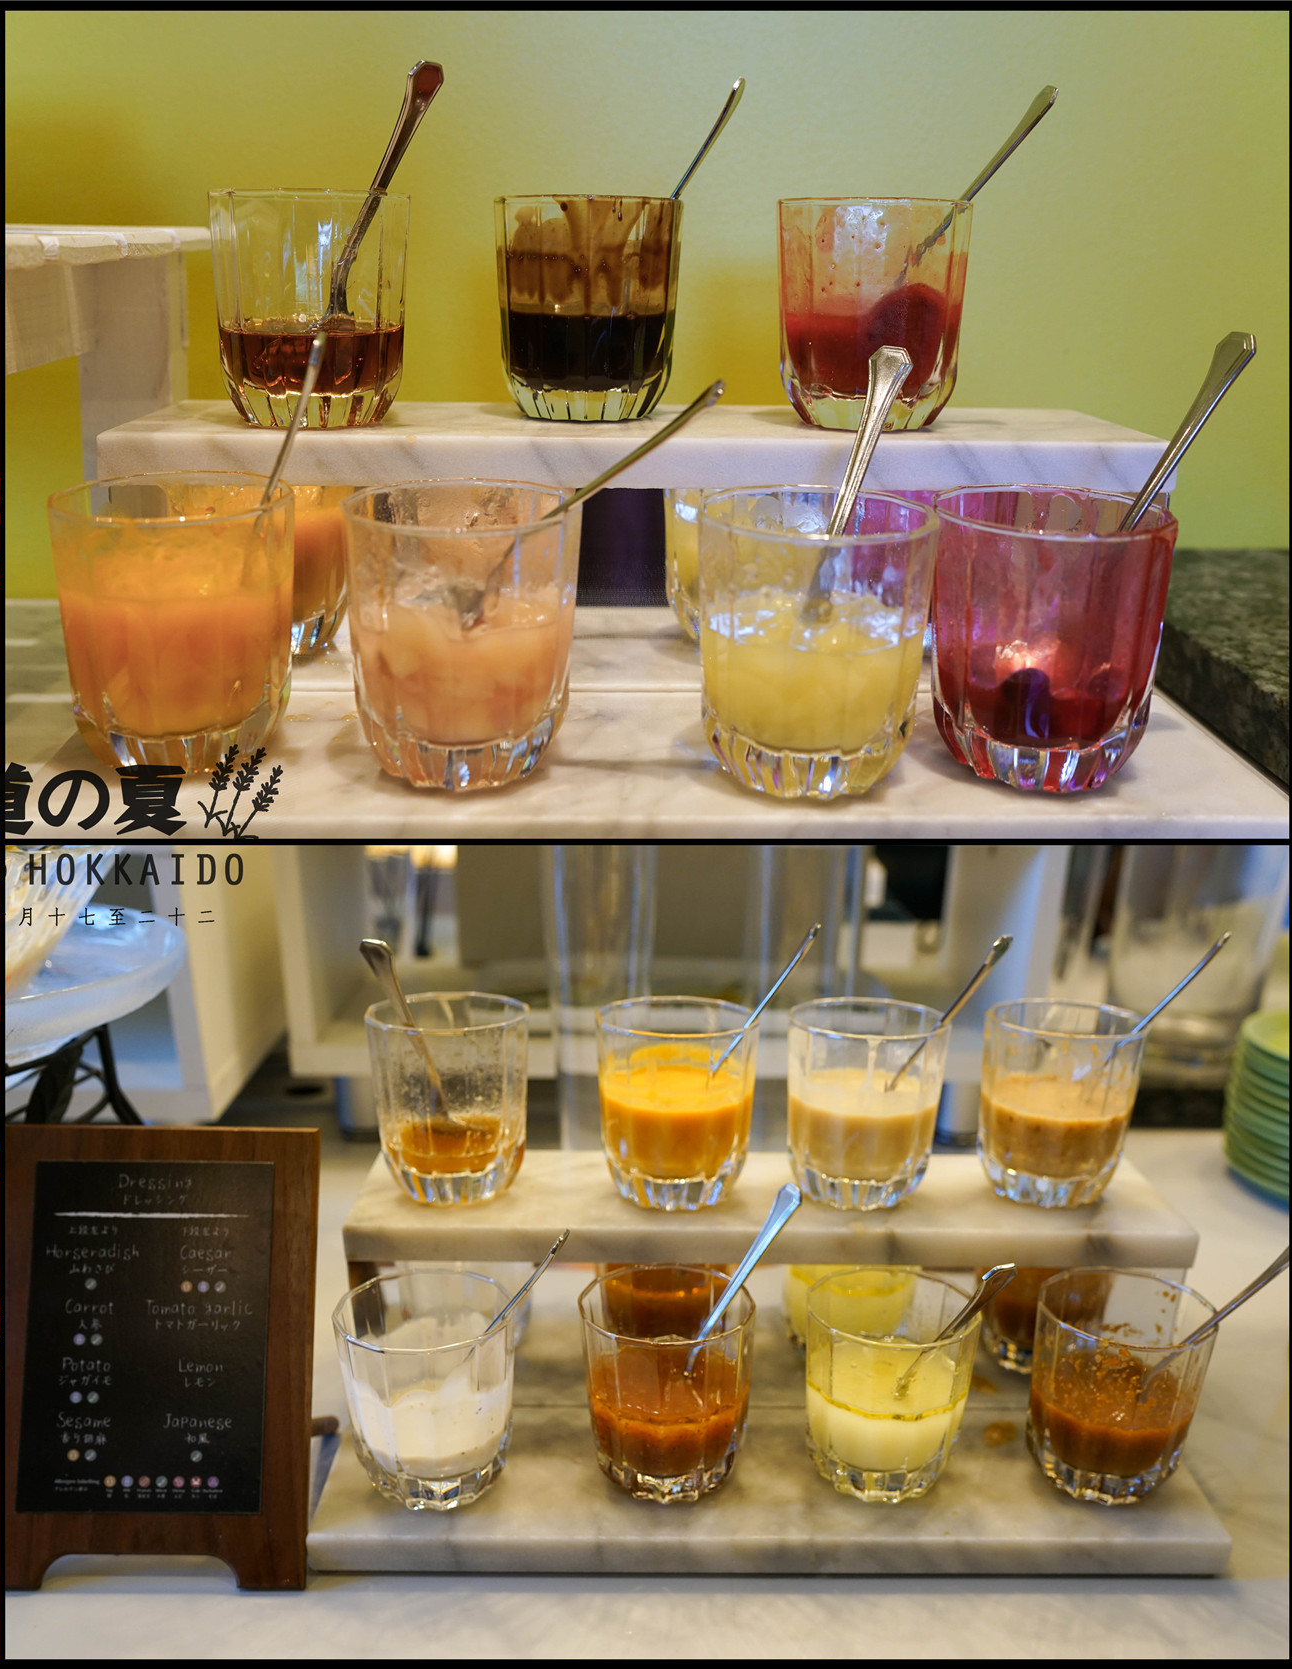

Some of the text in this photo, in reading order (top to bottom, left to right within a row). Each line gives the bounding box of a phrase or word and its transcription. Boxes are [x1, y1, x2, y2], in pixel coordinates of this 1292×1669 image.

[118, 1173, 193, 1190] Dressing
[46, 1243, 140, 1261] Horseradish
[179, 1245, 232, 1261] Caesar
[64, 1298, 114, 1315] Carrot
[146, 1299, 253, 1316] Tomato garlic
[154, 1318, 241, 1331] トマトガーリック
[62, 1356, 112, 1372] Potato
[178, 1359, 224, 1373] Lemon
[57, 1411, 111, 1430] Sesame
[162, 1413, 233, 1430] Japanese
